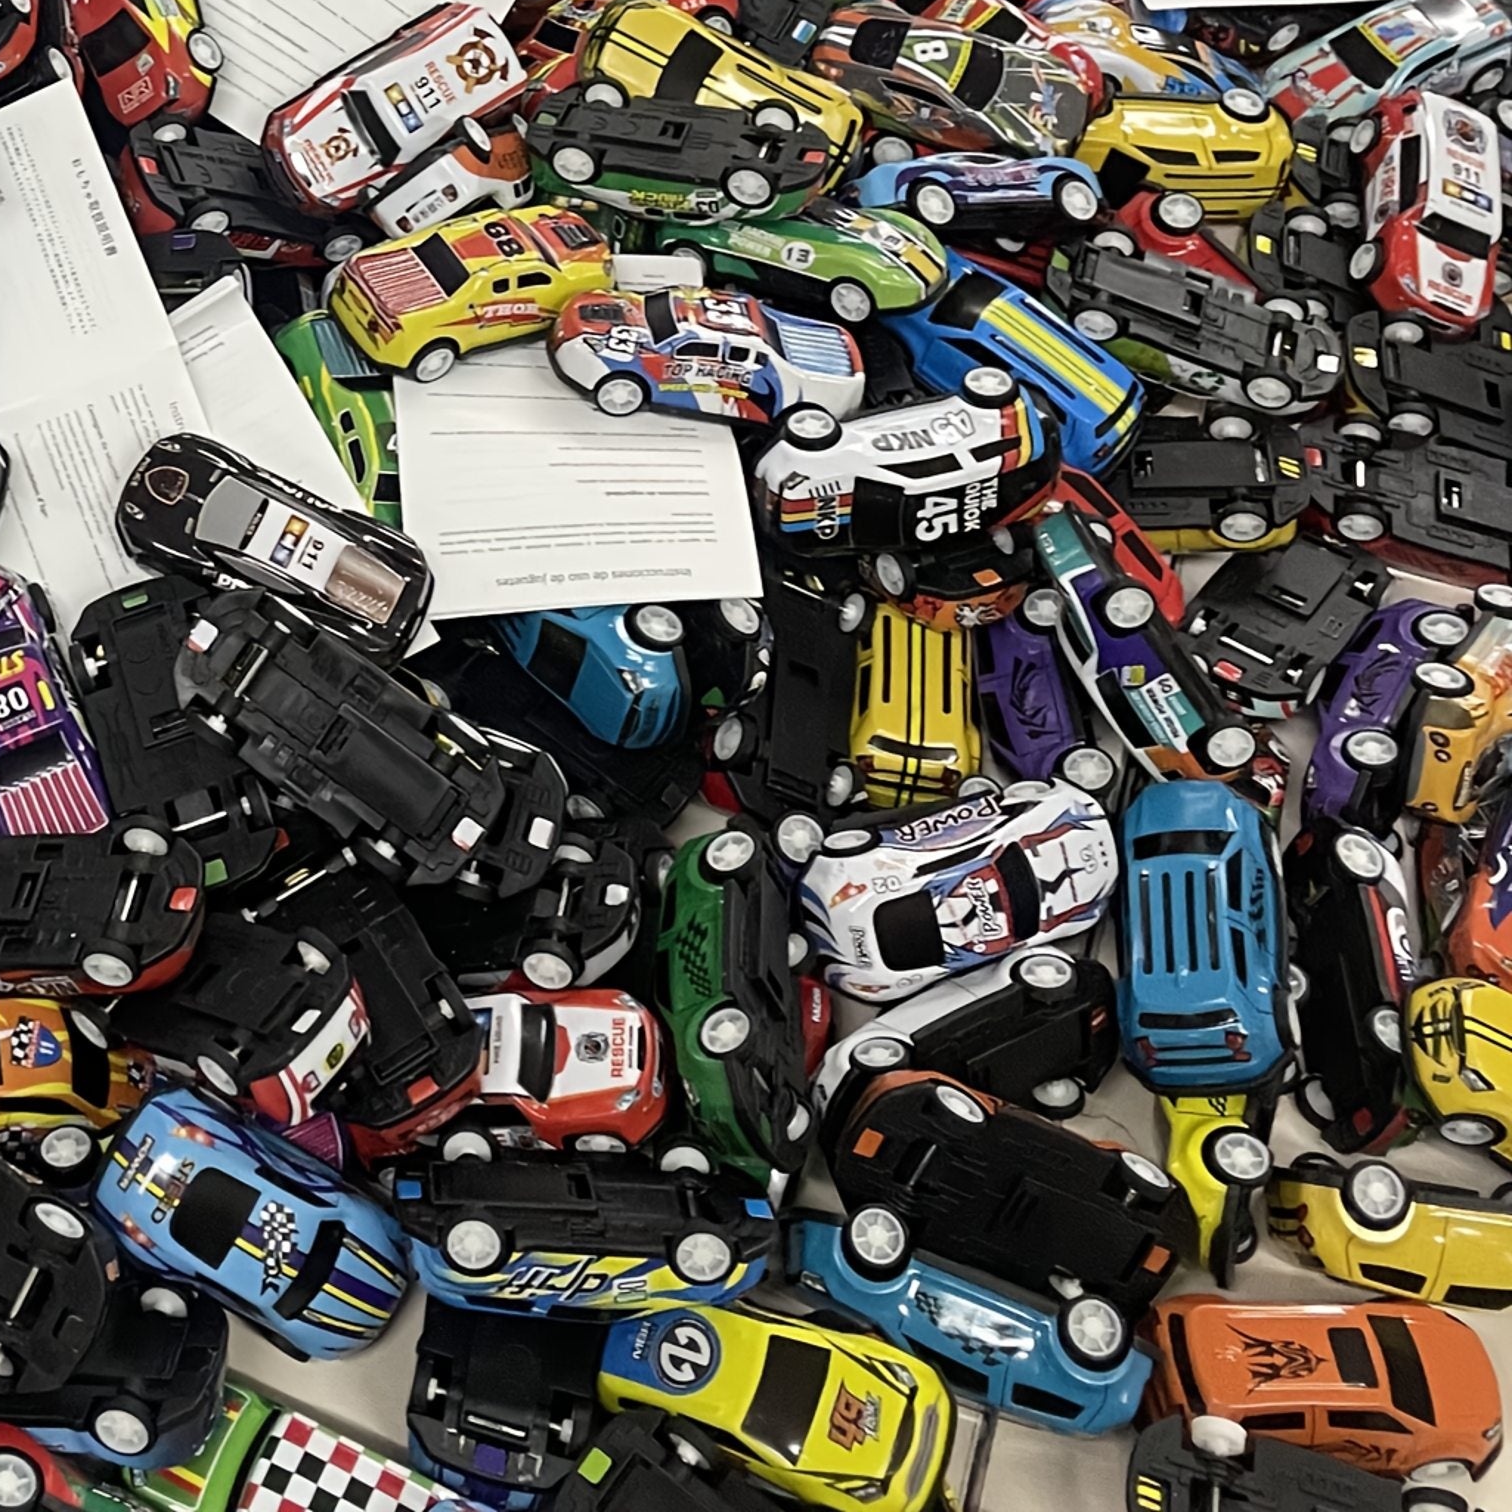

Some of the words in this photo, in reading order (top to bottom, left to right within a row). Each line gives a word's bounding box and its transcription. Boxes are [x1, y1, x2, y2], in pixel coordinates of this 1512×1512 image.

[913, 39, 949, 62] 8
[414, 76, 441, 109] 911
[663, 362, 691, 379] TOP
[695, 363, 752, 384] RACING
[872, 430, 935, 452] NKP
[815, 496, 840, 540] NKP
[916, 496, 959, 542] 45
[896, 794, 1001, 843] POWER
[965, 874, 1001, 940] POWER
[610, 1017, 626, 1079] RESCUE
